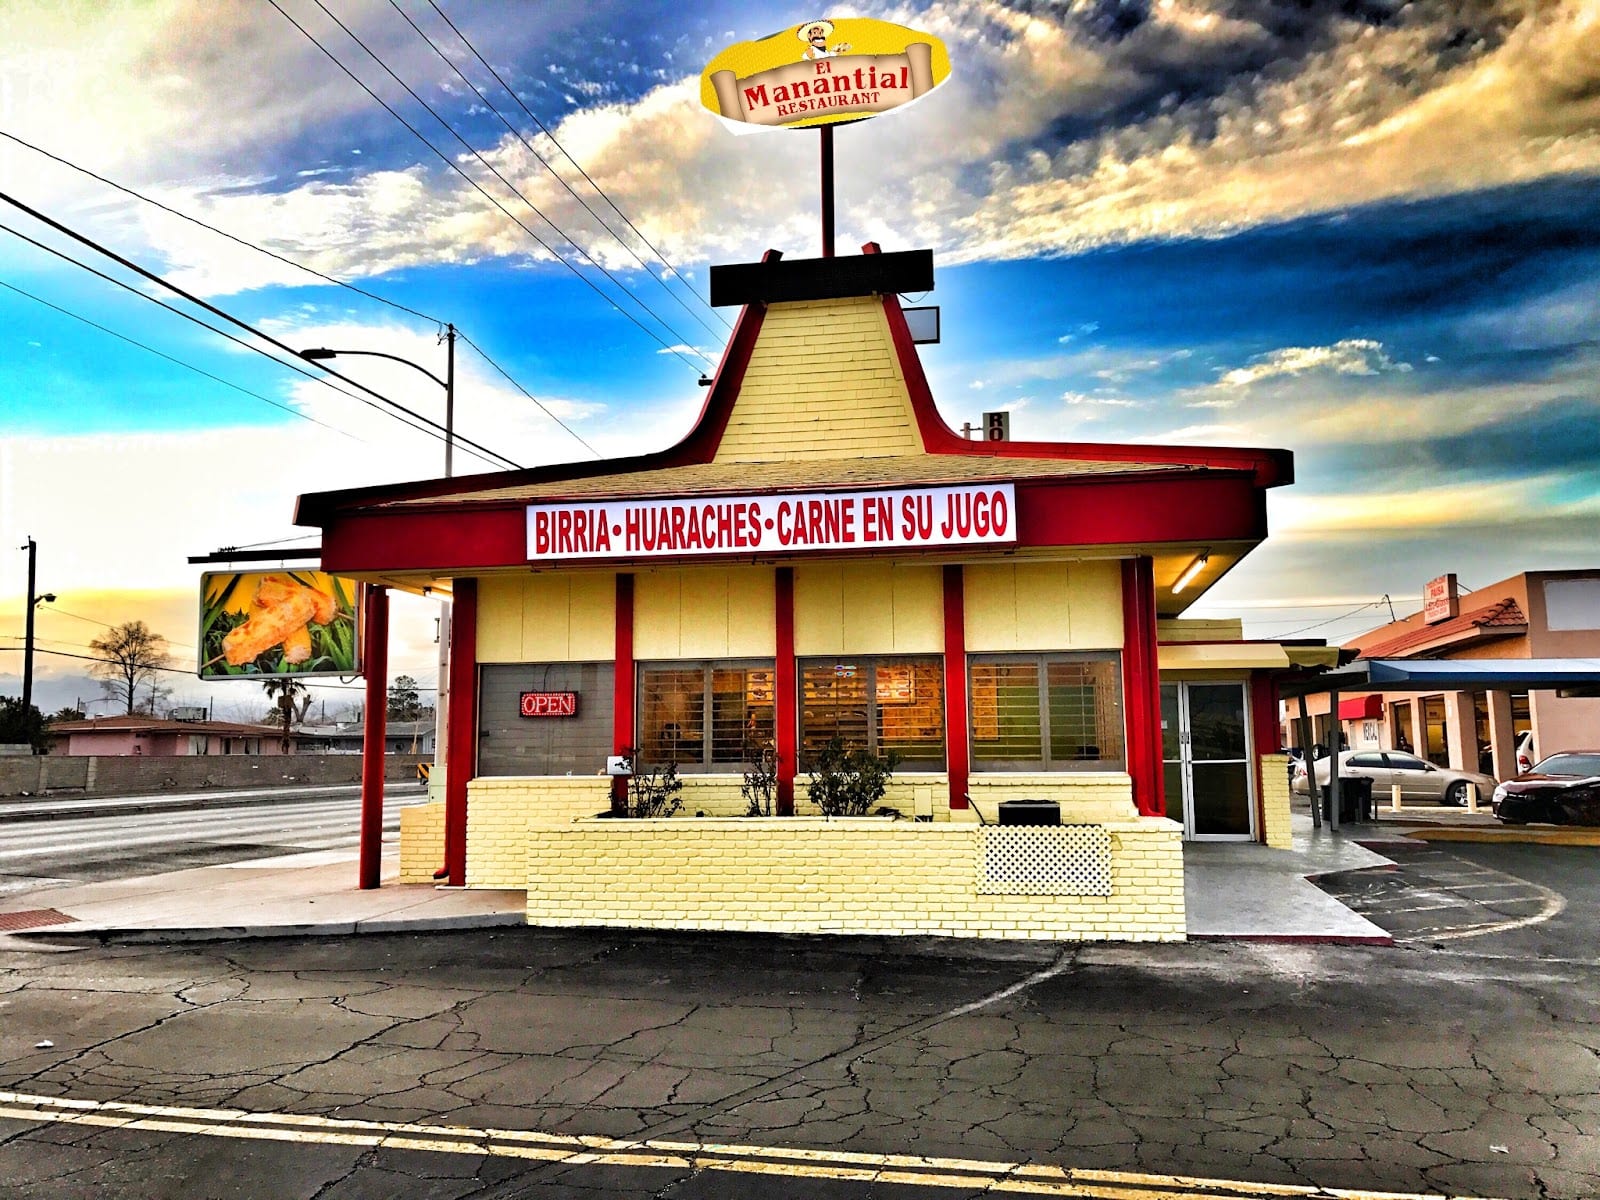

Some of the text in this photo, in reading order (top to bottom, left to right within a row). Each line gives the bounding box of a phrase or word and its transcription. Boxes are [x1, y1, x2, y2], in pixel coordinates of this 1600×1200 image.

[815, 61, 831, 75] El
[743, 66, 909, 111] Manantial
[777, 92, 880, 117] RESTAURANT
[535, 490, 1008, 554] BIRRIA HUARACHES CARNE EN SU JUGO
[524, 696, 573, 713] OPEN
